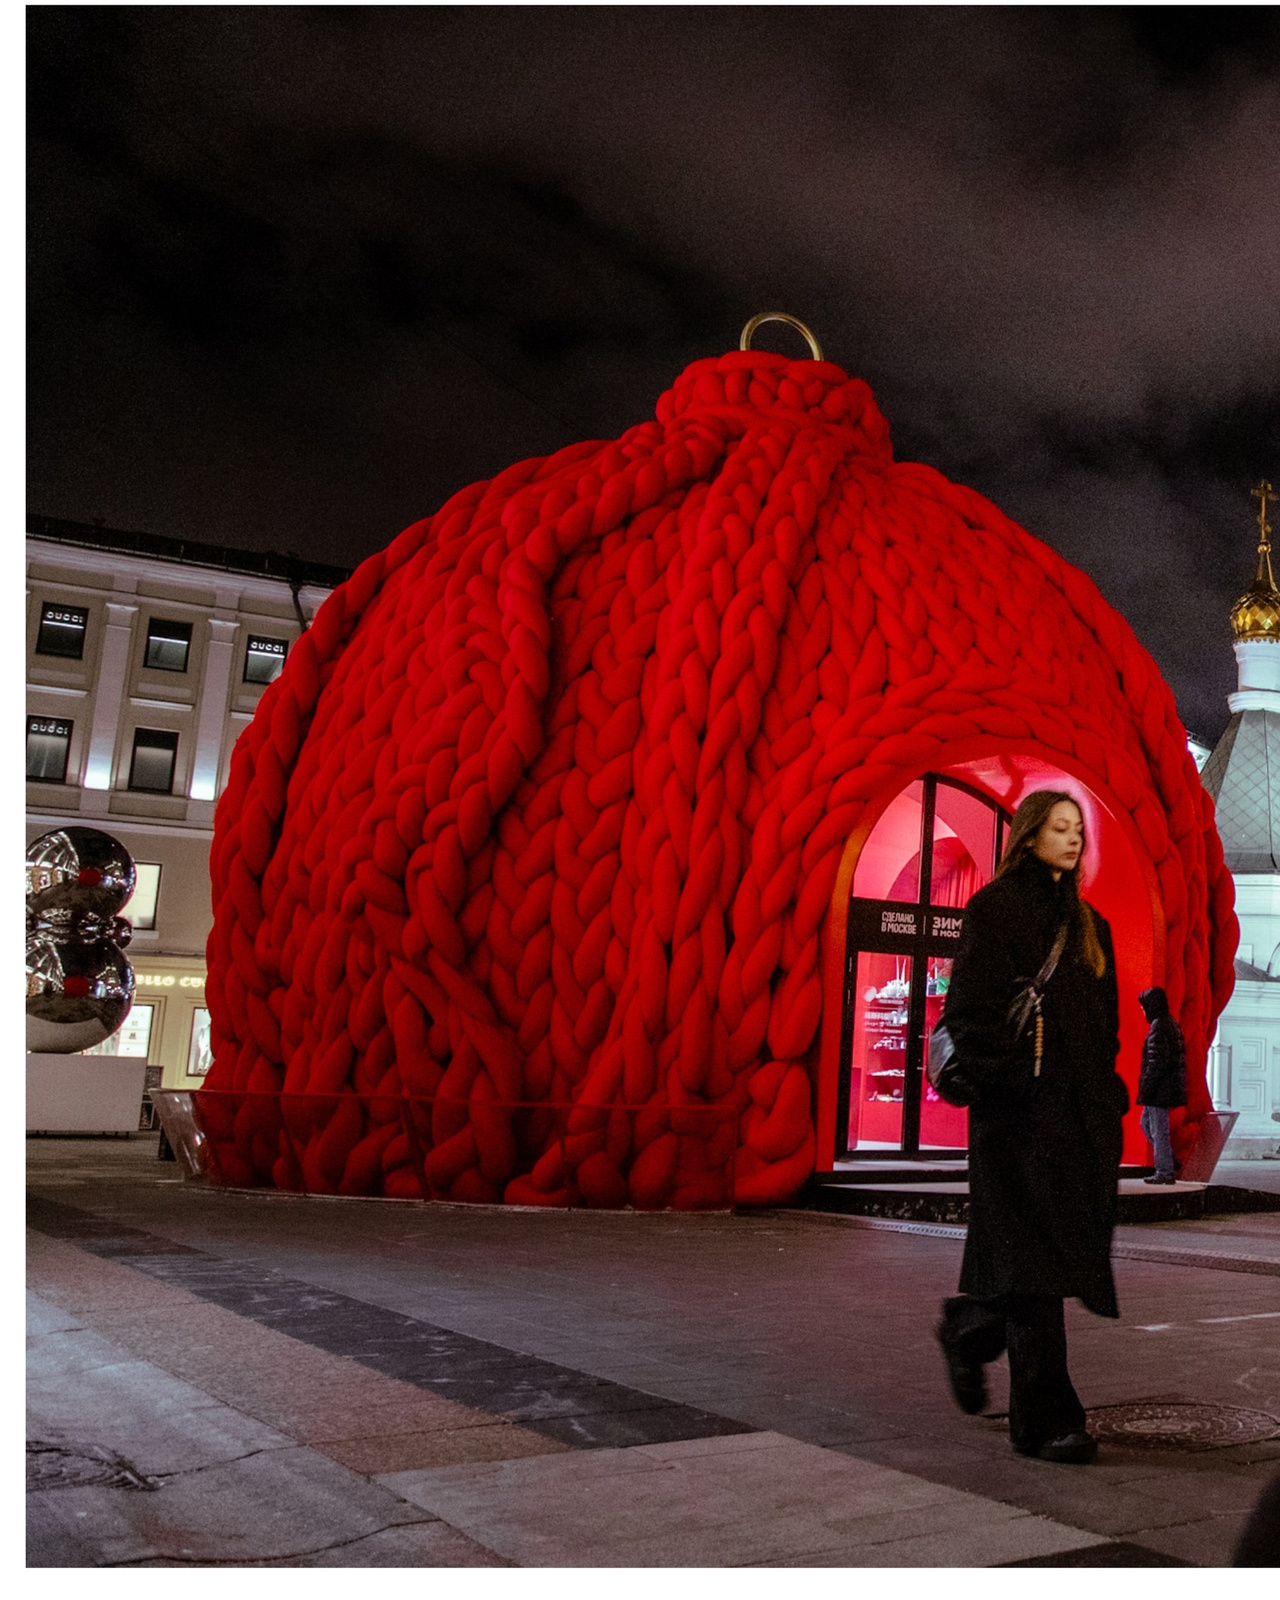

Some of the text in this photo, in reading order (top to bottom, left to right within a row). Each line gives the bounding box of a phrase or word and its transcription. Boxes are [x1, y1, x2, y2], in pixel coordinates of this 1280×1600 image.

[46, 611, 83, 623] GUCCI
[250, 641, 284, 653] GUCCI
[31, 723, 69, 735] GUCCI
[881, 911, 915, 924] СДЕЛАНО
[932, 916, 963, 930] ЗИМ
[881, 922, 917, 935] В МОСКВЕ
[135, 974, 175, 986] ELLO
